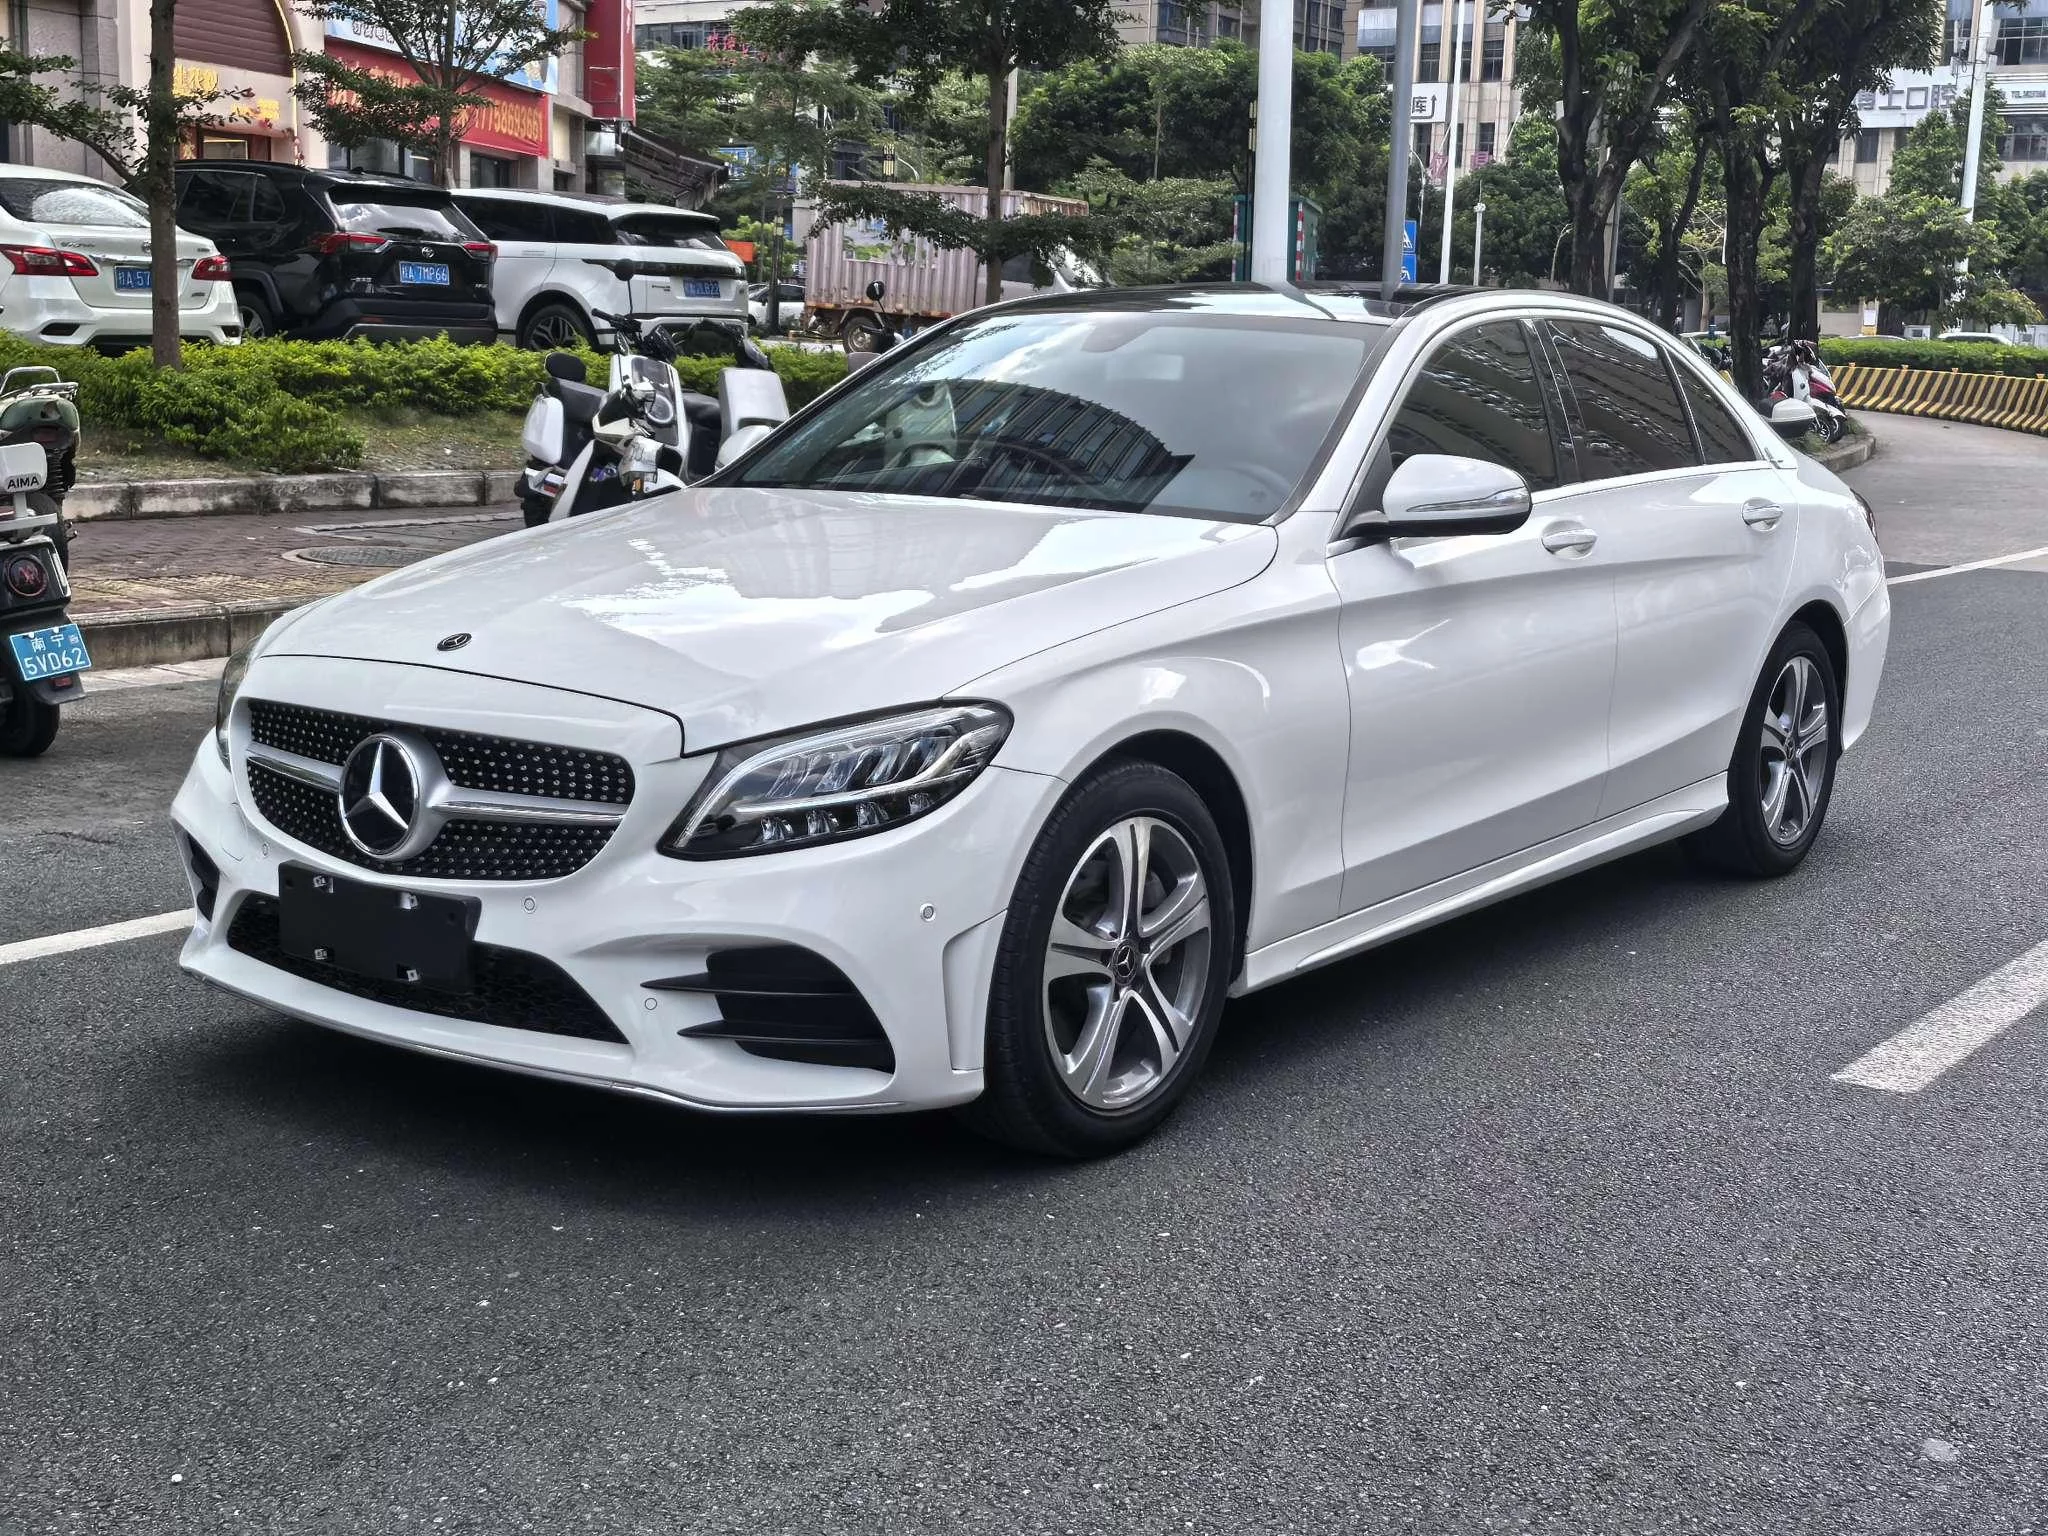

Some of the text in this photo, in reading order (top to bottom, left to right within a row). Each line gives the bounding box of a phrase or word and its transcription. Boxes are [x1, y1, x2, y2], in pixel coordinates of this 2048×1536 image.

[1411, 96, 1427, 113] 库
[7, 476, 40, 490] AIMA
[31, 634, 65, 652] 南宁
[24, 647, 86, 675] 5VD62
